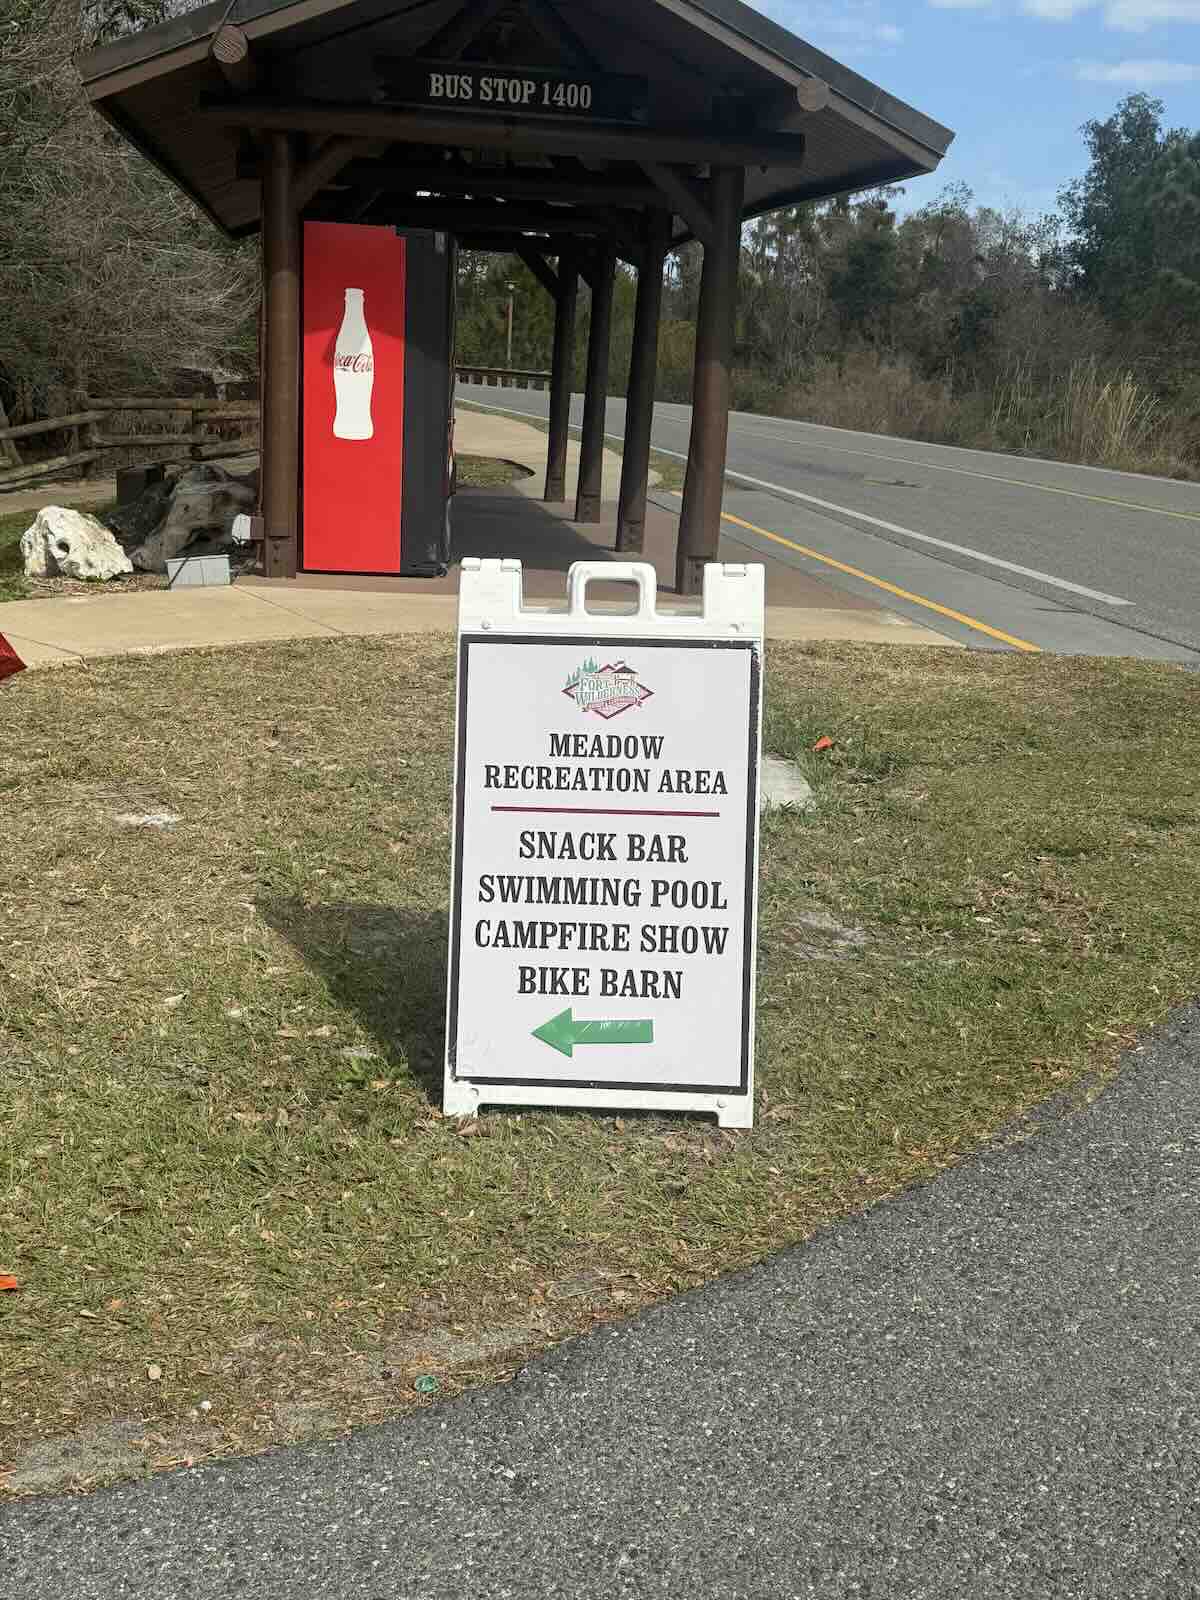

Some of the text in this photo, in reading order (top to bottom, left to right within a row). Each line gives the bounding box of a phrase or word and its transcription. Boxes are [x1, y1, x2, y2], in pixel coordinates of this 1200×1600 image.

[429, 73, 592, 109] BUS STOP 1400
[549, 733, 665, 759] MEADOW
[483, 764, 729, 795] RECREATION AREA
[519, 830, 689, 864] SNACK BAR
[478, 874, 728, 910] SWIMMING POOL
[474, 919, 729, 955] CAMPFIRE SHOW
[518, 966, 683, 999] BIKE BARN
